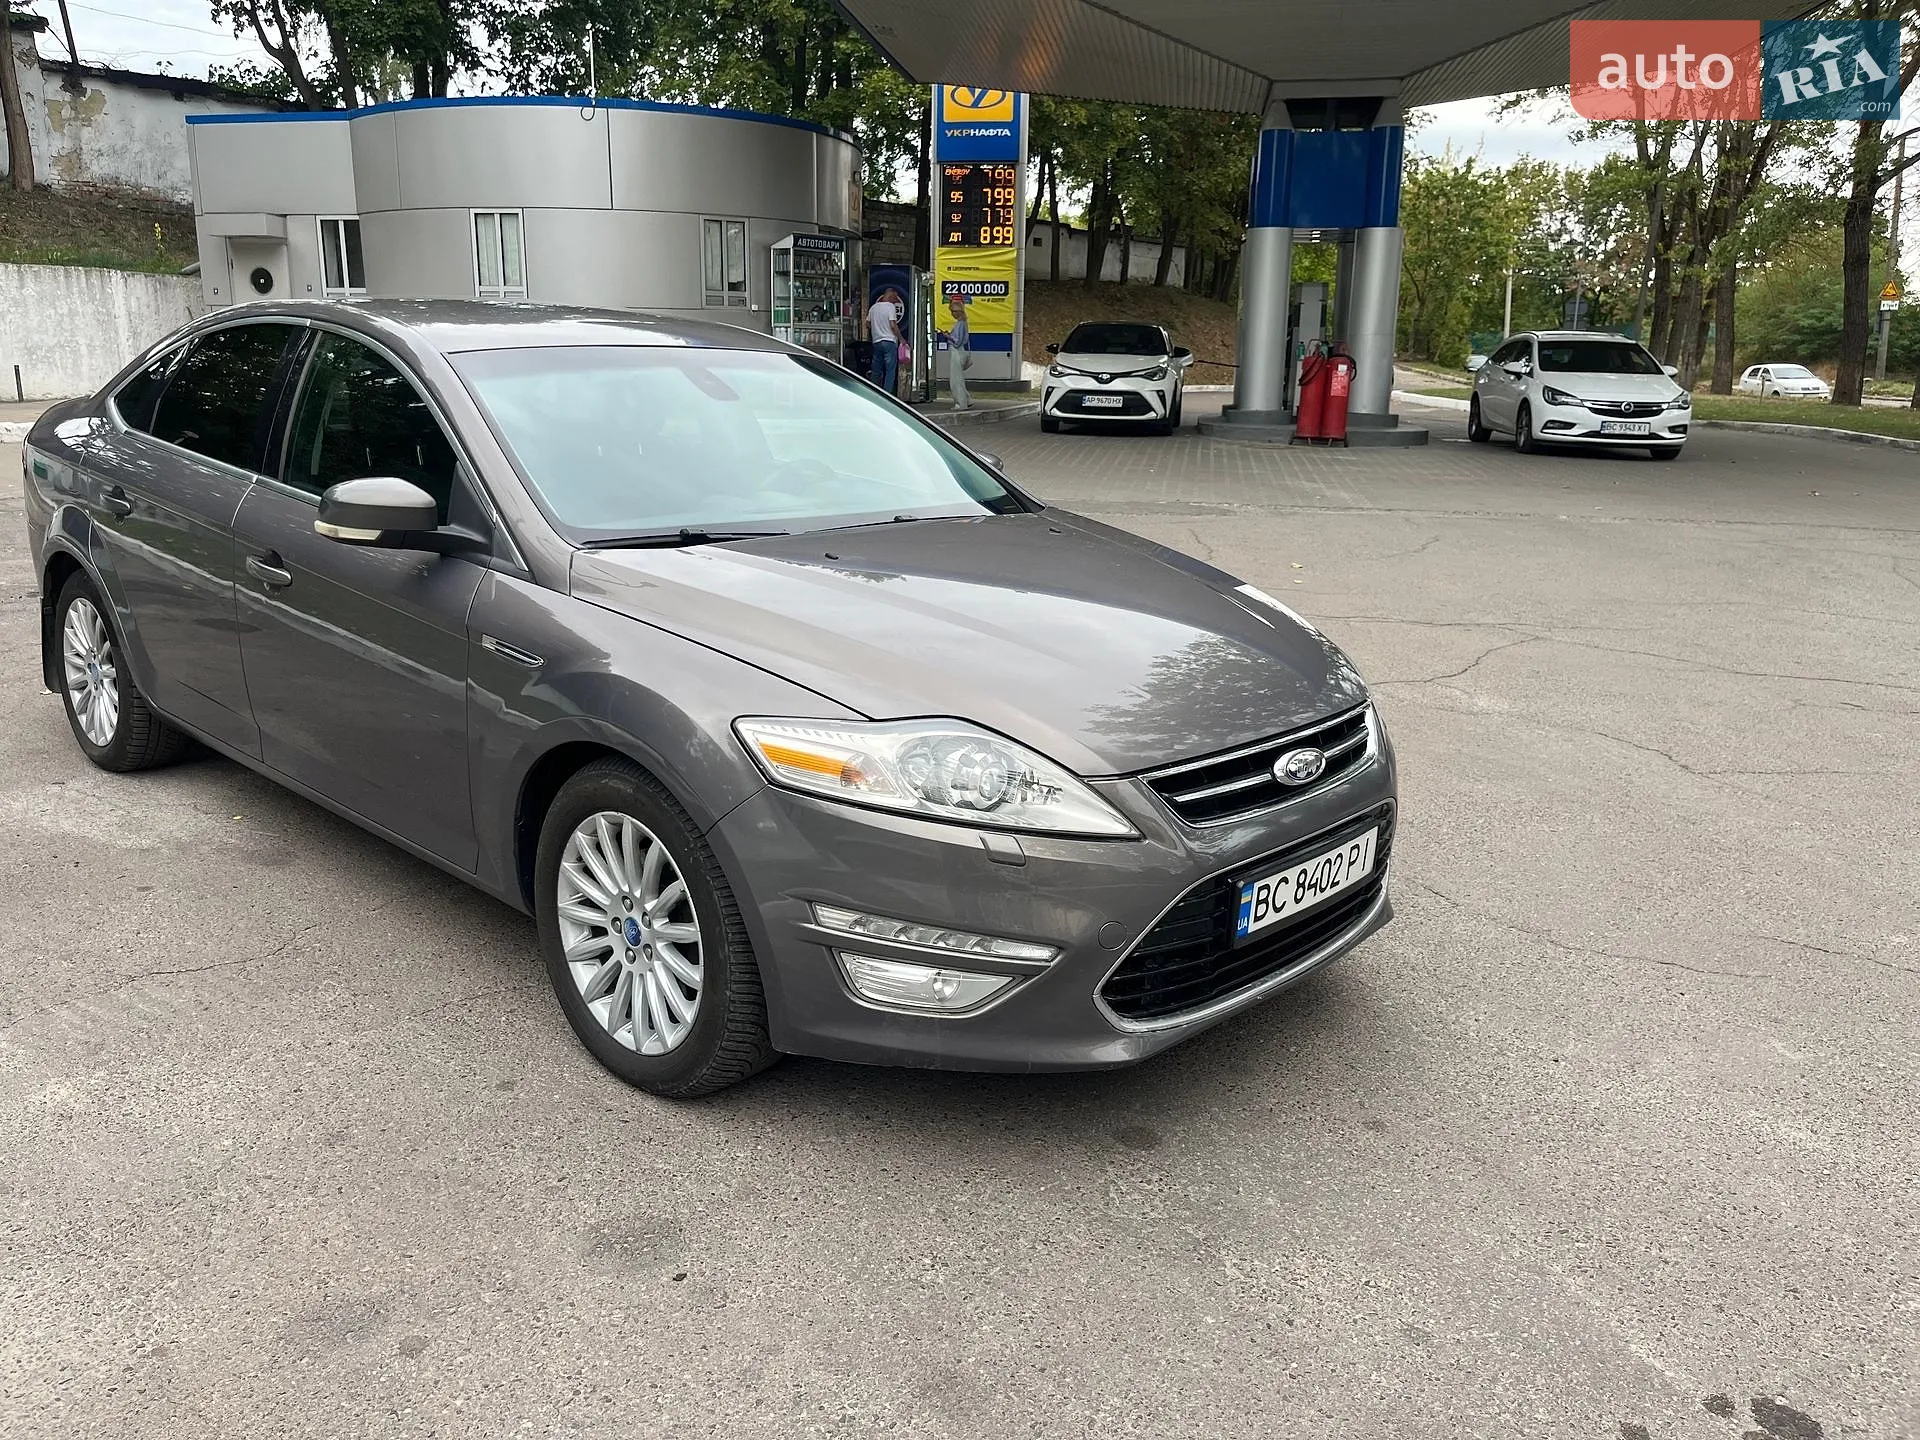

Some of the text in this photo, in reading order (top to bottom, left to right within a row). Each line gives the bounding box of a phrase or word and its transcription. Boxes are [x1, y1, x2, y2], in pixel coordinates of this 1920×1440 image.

[945, 128, 1011, 137] УКРНАФТА
[950, 187, 1015, 206] 95 799
[982, 207, 1014, 225] 779
[980, 226, 1013, 244] 899
[797, 238, 840, 250] АВТОТОВАРИ
[945, 283, 1005, 294] 22 000 000
[1253, 838, 1369, 923] BC 8402 PI
[1237, 916, 1248, 930] UA
